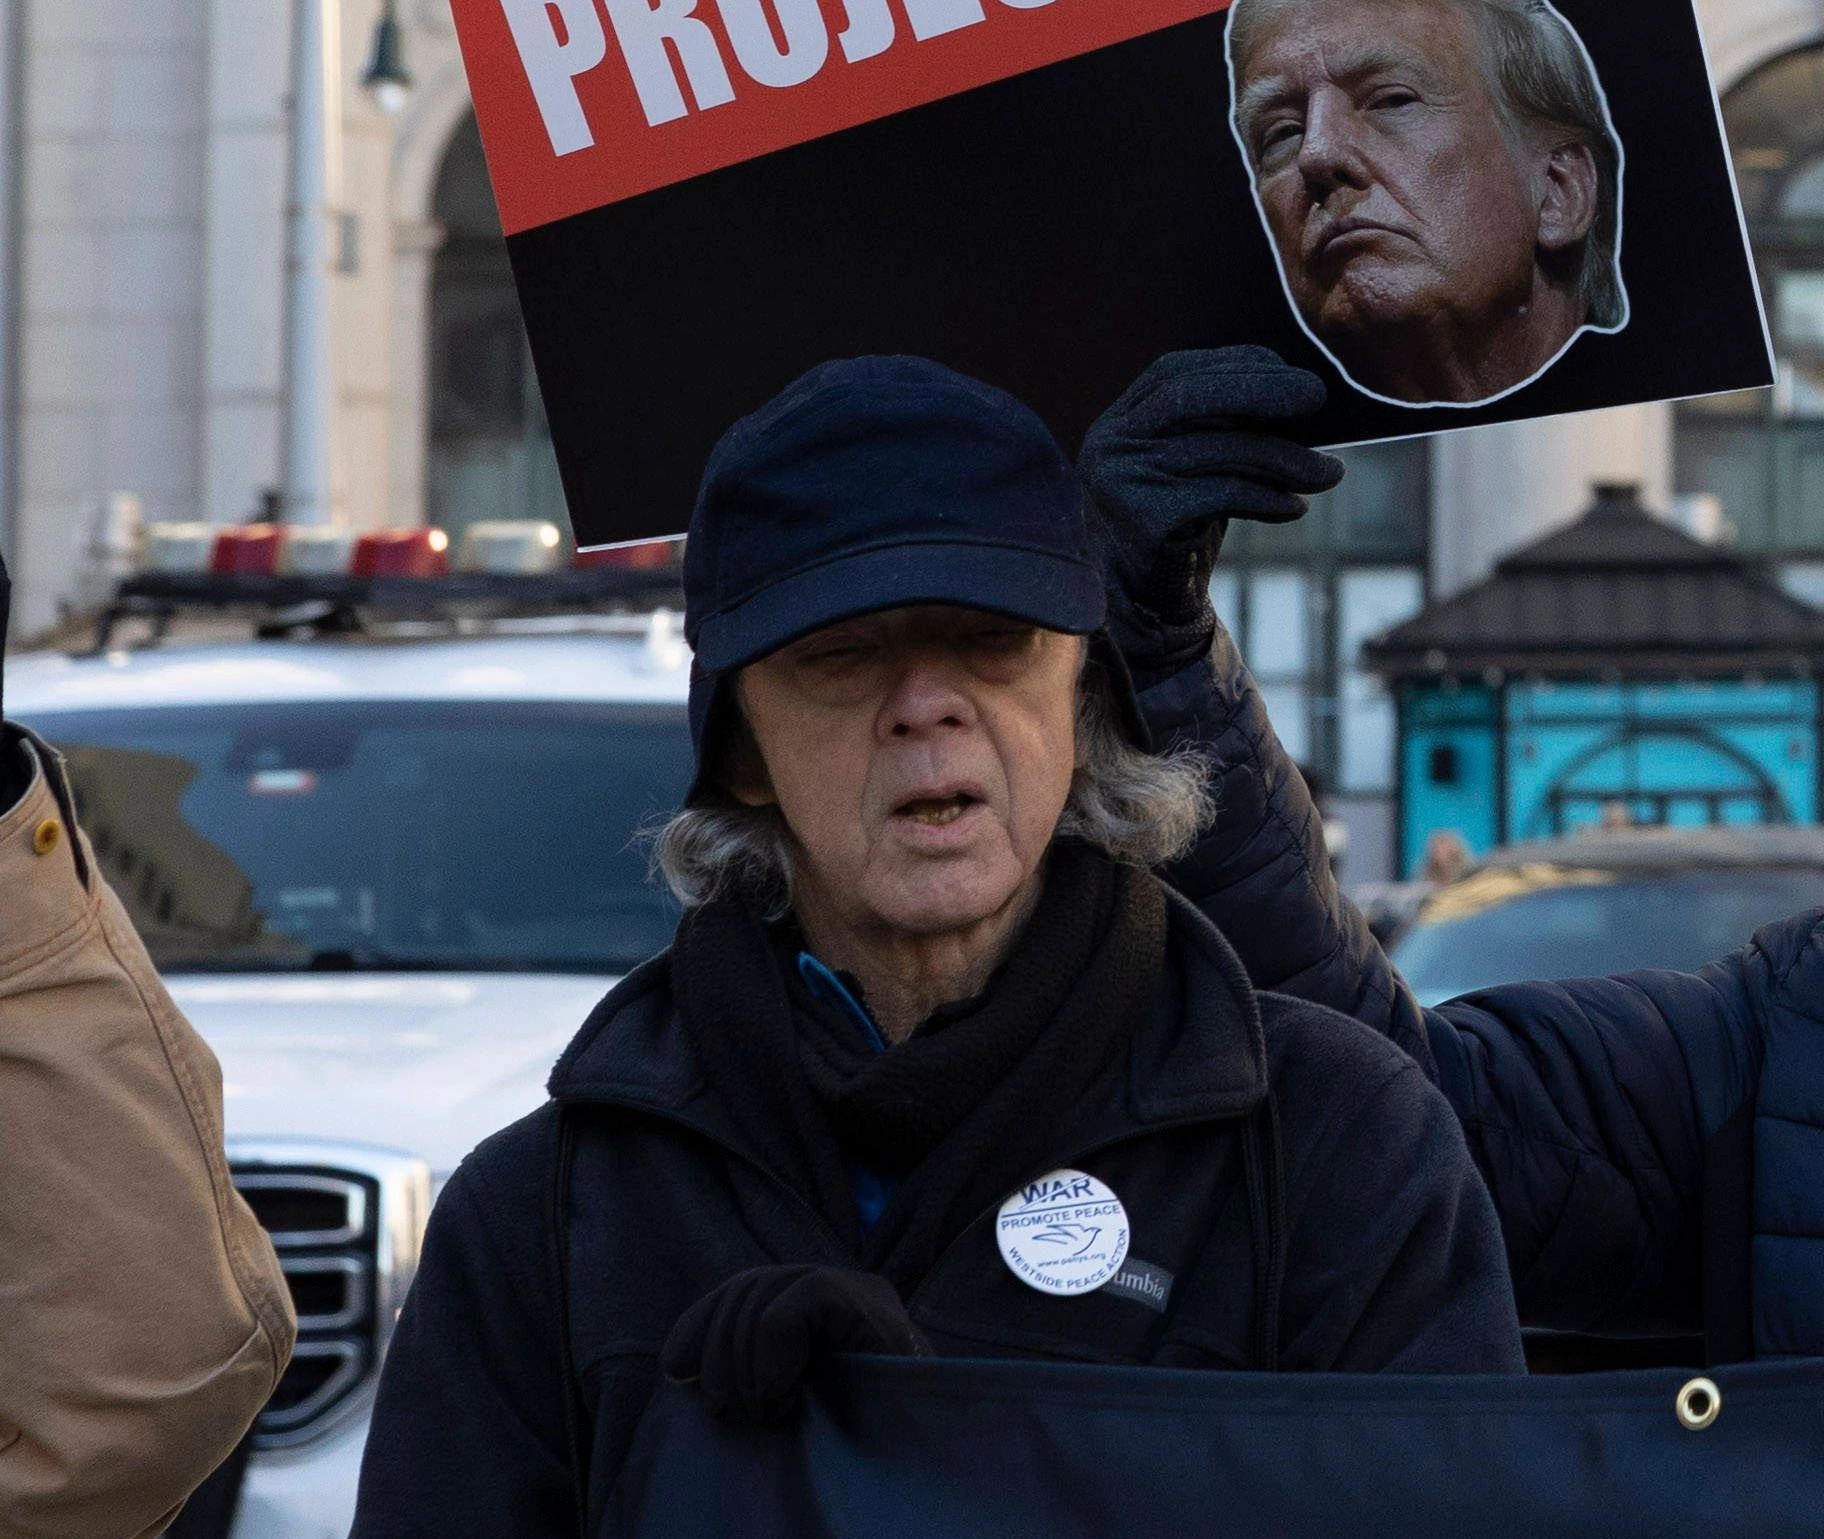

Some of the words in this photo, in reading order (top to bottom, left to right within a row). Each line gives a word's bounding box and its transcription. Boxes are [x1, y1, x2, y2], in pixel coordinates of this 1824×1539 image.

[1021, 1177, 1094, 1204] WAR
[1001, 1210, 1071, 1231] PROMOTE
[1074, 1204, 1121, 1220] PEACE
[1009, 1246, 1064, 1289] WESTSIDE
[1066, 1268, 1107, 1289] PEACE
[1107, 1228, 1127, 1272] ACTION
[1113, 1271, 1165, 1301] umbia
